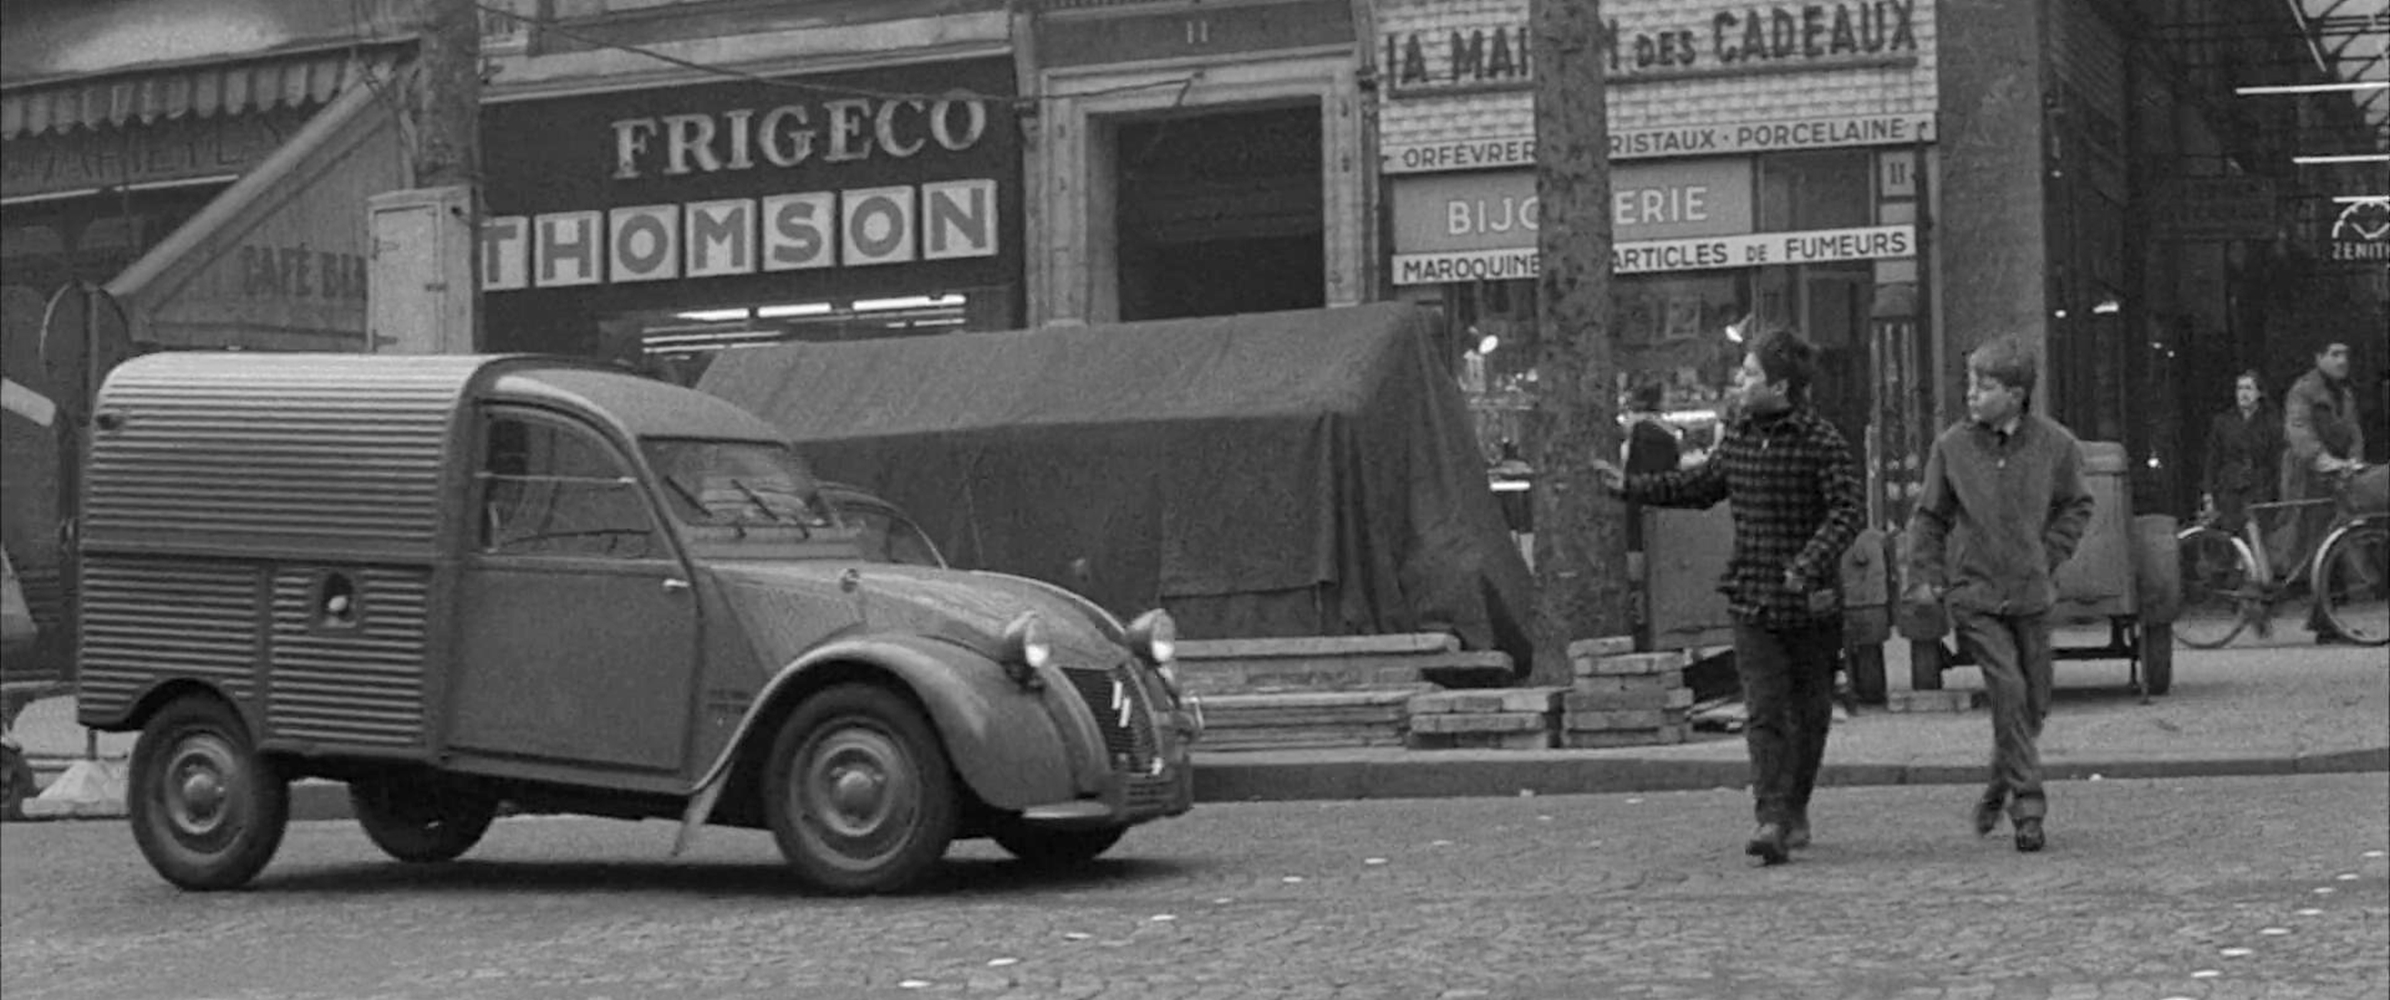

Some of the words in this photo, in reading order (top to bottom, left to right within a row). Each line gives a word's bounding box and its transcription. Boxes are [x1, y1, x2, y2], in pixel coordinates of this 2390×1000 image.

[1186, 20, 1208, 44] 11
[1452, 19, 1618, 81] MAIN
[1635, 30, 1696, 68] DES
[1713, 1, 1918, 63] CADEAUX
[611, 87, 986, 180] FRIGECO
[1403, 141, 1538, 168] ORFÈVRER
[1610, 128, 1716, 155] RISTAUX
[1737, 118, 1905, 147] PORCELAINE
[481, 187, 988, 283] THOMSON
[1448, 186, 1708, 235] BIJOERIE
[1403, 254, 1540, 282] MAROQUINE
[1746, 244, 1768, 263] DE
[1785, 231, 1908, 260] FUMEURS
